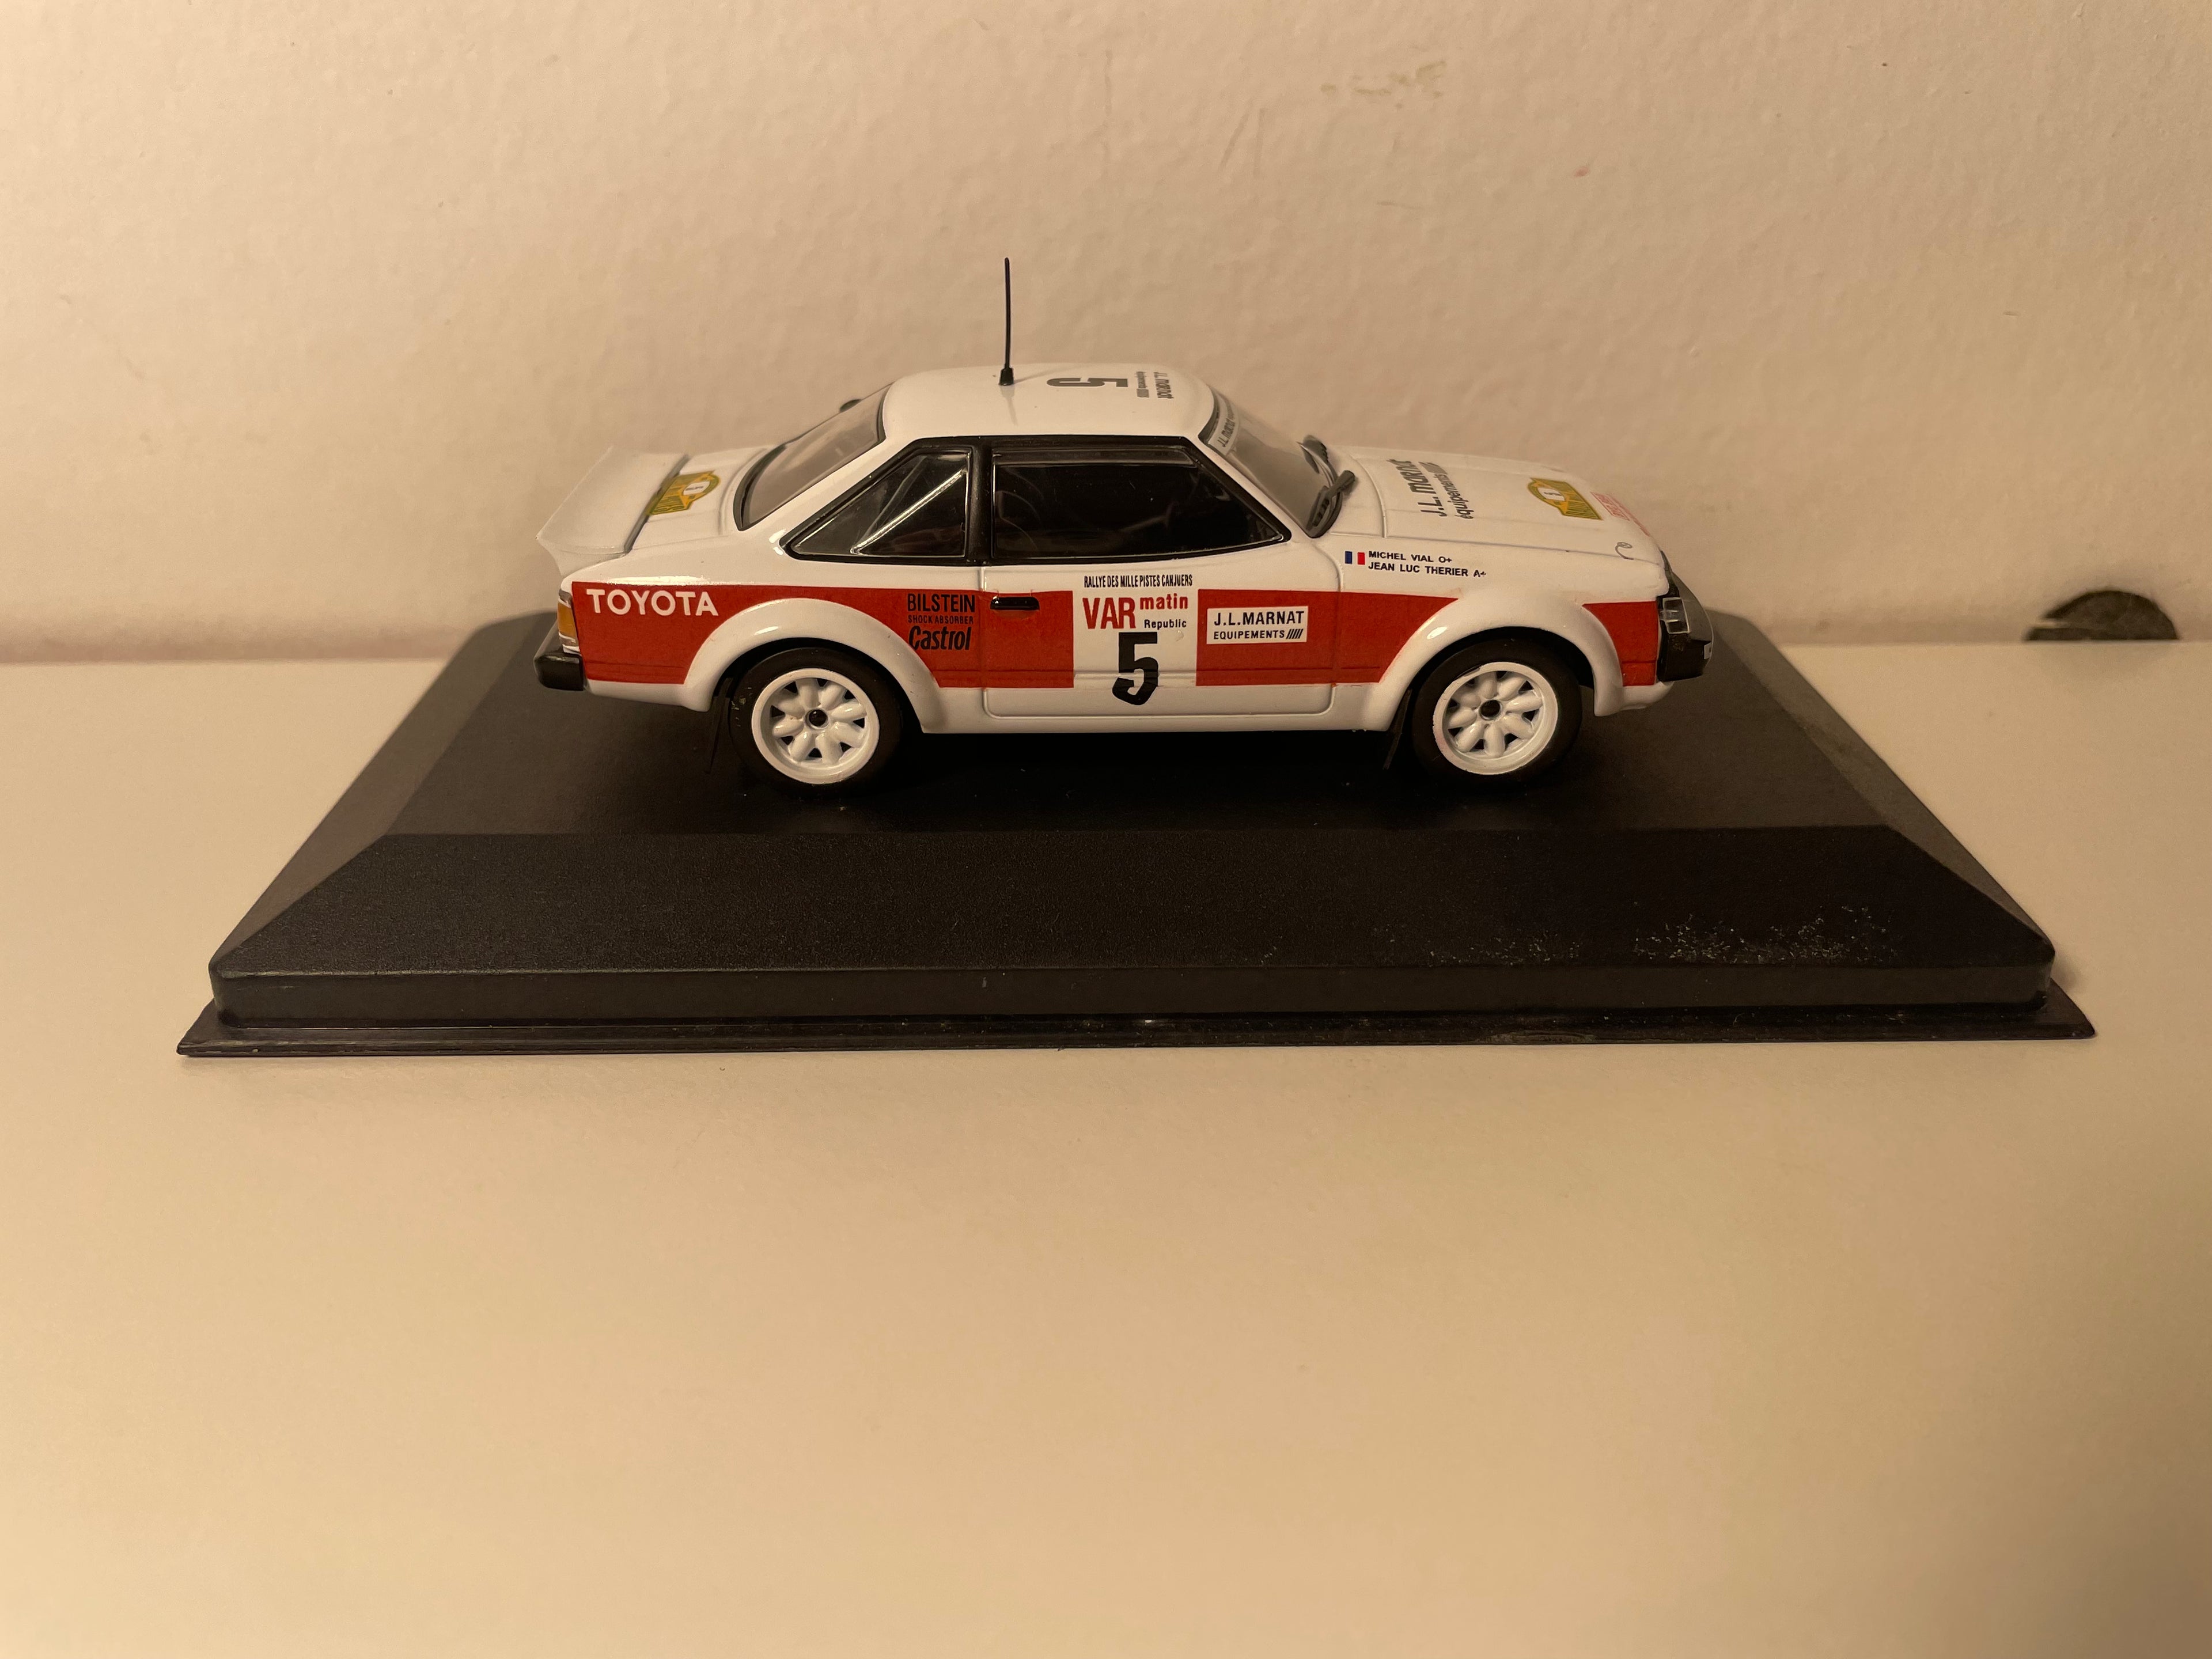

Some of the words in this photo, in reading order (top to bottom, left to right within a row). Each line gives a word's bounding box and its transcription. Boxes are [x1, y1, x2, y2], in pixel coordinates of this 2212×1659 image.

[1418, 496, 1448, 517] J.L.
[1368, 551, 1407, 560] MICHEL
[1411, 554, 1434, 562] VIAL
[1368, 562, 1395, 571] JEAN
[1400, 564, 1420, 573] LUC
[1425, 566, 1468, 577] THERIER
[1084, 575, 1106, 588] RALLYE
[1107, 575, 1119, 588] DES
[1120, 575, 1138, 588] MILLE
[1139, 574, 1160, 588] PISTES
[586, 589, 719, 616] TOYOTA
[908, 593, 975, 613] BILSTEIN
[908, 615, 933, 624] SHOCK
[934, 615, 974, 624] ABSORBER
[1082, 597, 1137, 630] VAR
[1140, 593, 1188, 610] matin
[1144, 619, 1187, 630] Republic
[908, 625, 972, 650] Castrol
[1214, 630, 1285, 640] EQUIPEMENTS
[1112, 631, 1158, 706] 5
